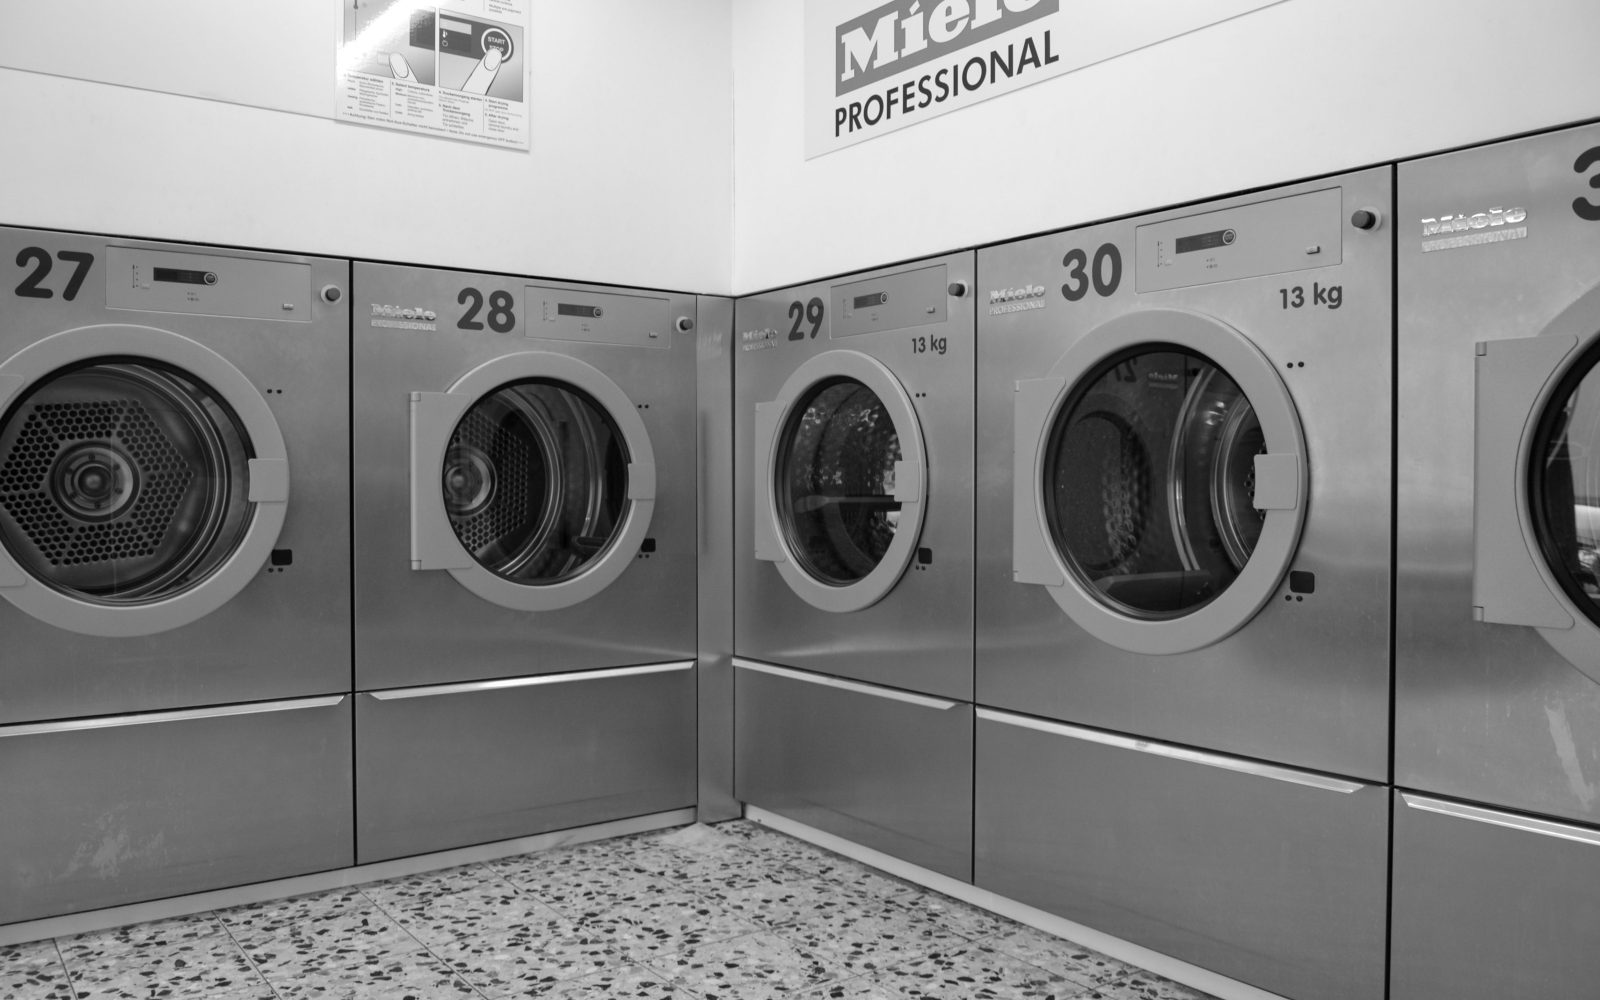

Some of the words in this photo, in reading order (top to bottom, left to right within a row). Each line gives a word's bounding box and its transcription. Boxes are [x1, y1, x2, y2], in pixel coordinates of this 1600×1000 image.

[487, 36, 506, 45] START
[841, 0, 1041, 82] Mie
[835, 30, 1060, 137] PROFESSIONAL
[1421, 206, 1527, 237] Miele
[14, 246, 95, 302] 27
[1061, 242, 1122, 302] 30
[456, 287, 516, 333] 28
[989, 284, 1046, 305] Miele
[989, 299, 1046, 316] PROFESSIONAL
[1279, 288, 1305, 310] 13
[1313, 282, 1343, 310] kg
[370, 303, 437, 321] Miele
[788, 296, 825, 342] 29
[911, 336, 926, 354] 13
[930, 334, 947, 355] kg
